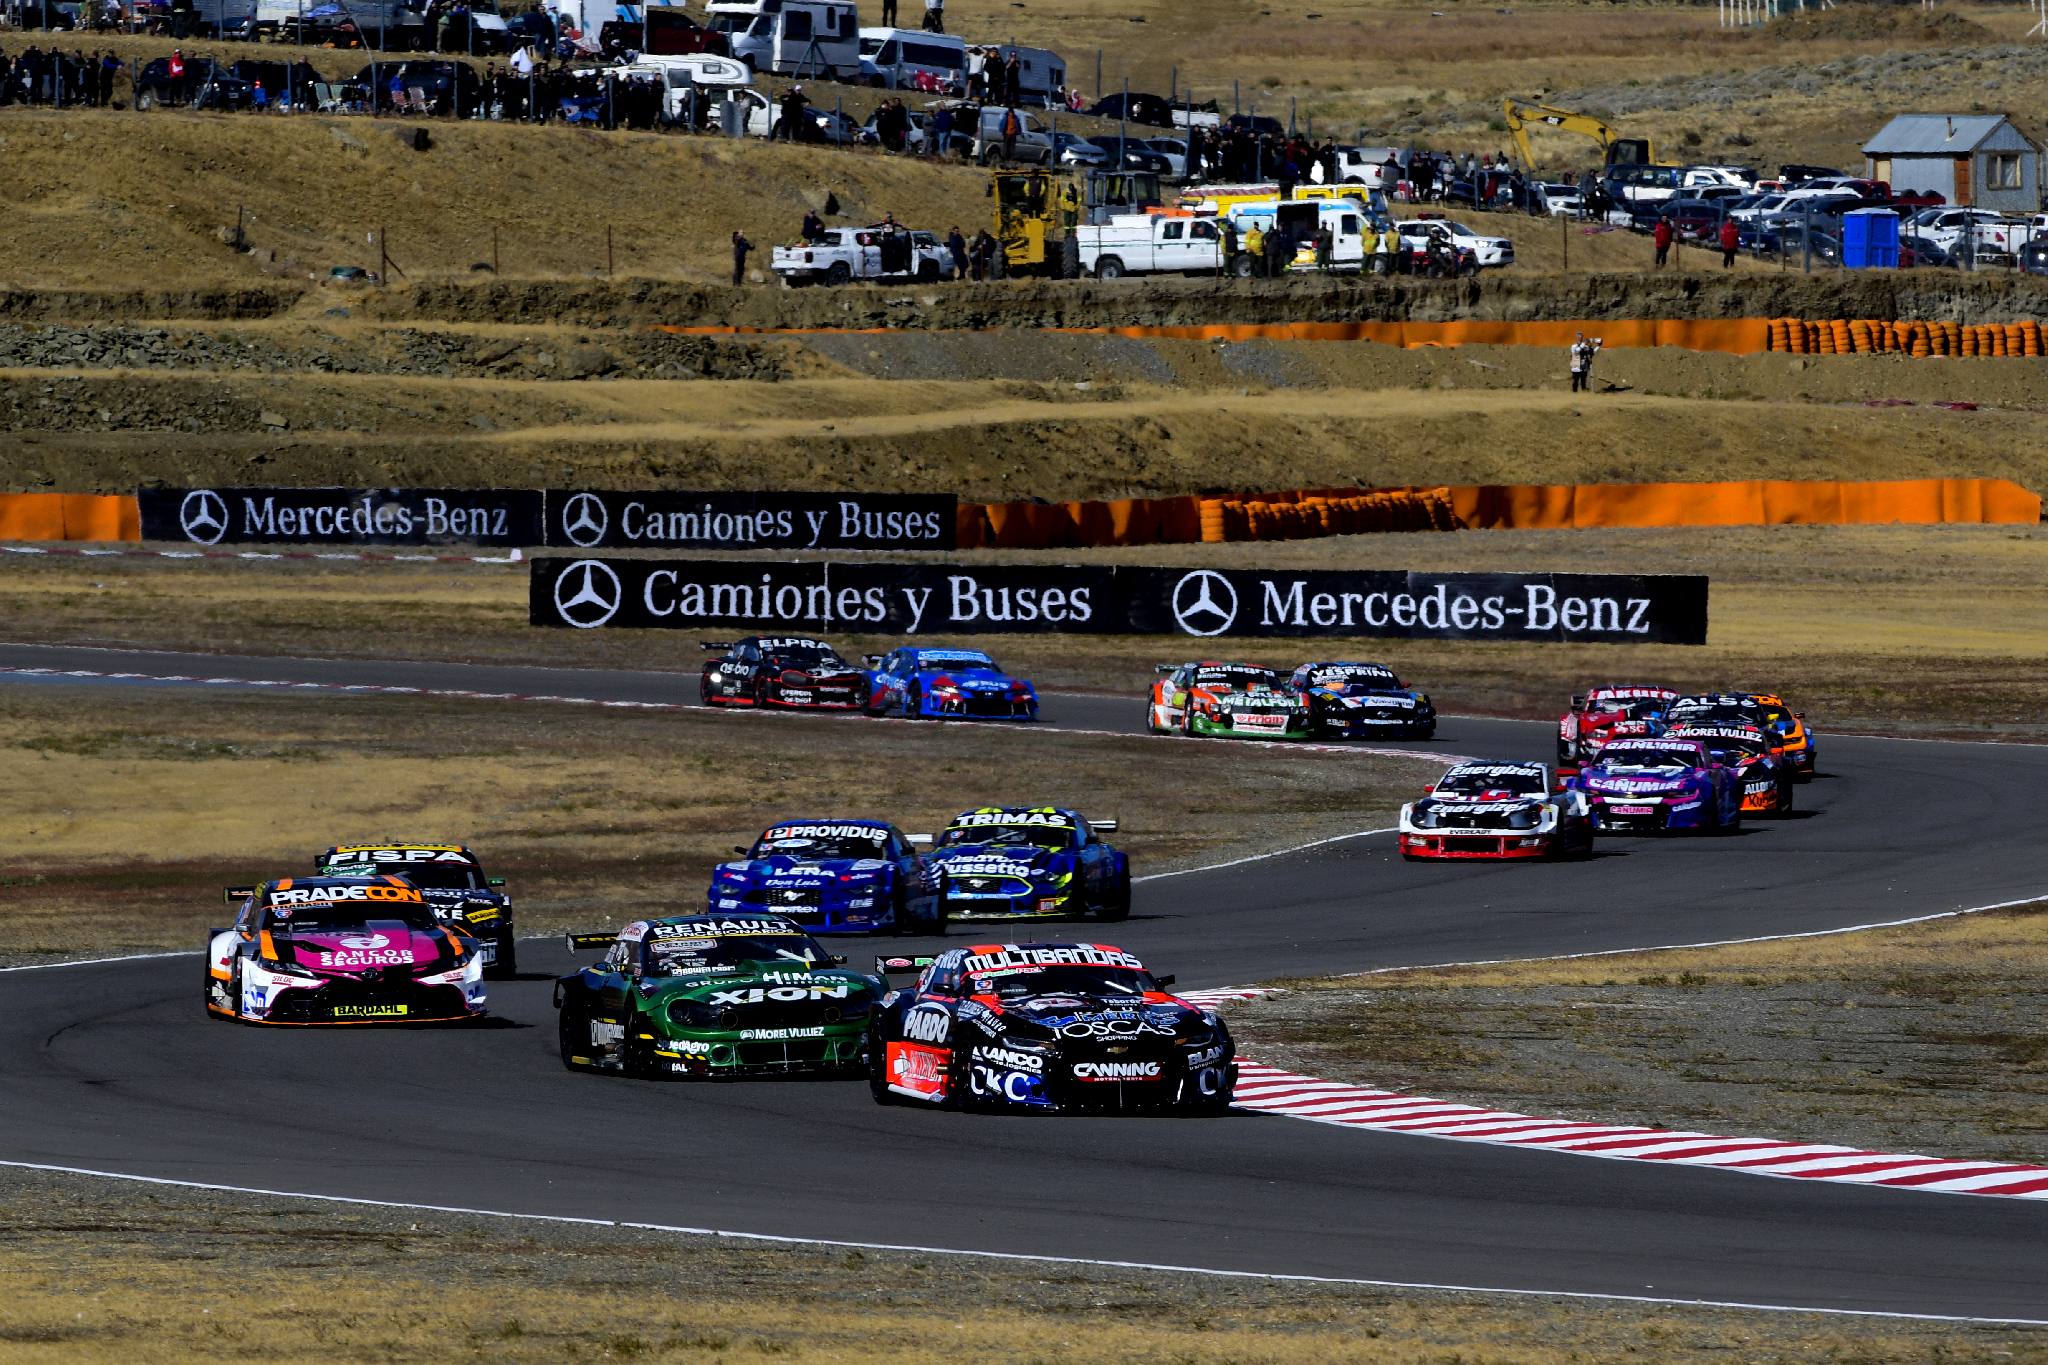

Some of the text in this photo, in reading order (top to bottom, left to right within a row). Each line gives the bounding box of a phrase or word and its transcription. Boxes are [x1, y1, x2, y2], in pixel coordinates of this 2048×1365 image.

[242, 497, 509, 536] Mercedes-Benz
[621, 501, 942, 547] Camiones y Buses
[643, 569, 1093, 634] Camiones y Buses
[1259, 580, 1651, 634] Mercedes-Benz
[758, 638, 832, 650] ELPRA
[1678, 728, 1763, 743] MOREL VULLIEZ
[1451, 765, 1541, 777] Energizer
[1427, 802, 1531, 817] Energizer
[957, 813, 1067, 826] TRIMAS
[791, 825, 888, 841] PROVIDUS
[328, 850, 472, 865] FISPA
[270, 885, 422, 905] PRADECON
[654, 919, 790, 935] RENAULT
[320, 949, 413, 958] SANCOR
[321, 956, 414, 967] SEGUROS
[963, 948, 1144, 973] MULTIBANDAS
[709, 985, 848, 1005] XION
[337, 1004, 403, 1015] BARDAHL
[755, 1027, 825, 1040] MOREL VULLIEZ
[903, 1009, 949, 1044] PARDO
[1052, 1021, 1177, 1041] TOSCAS
[1073, 1061, 1161, 1078] CANNING
